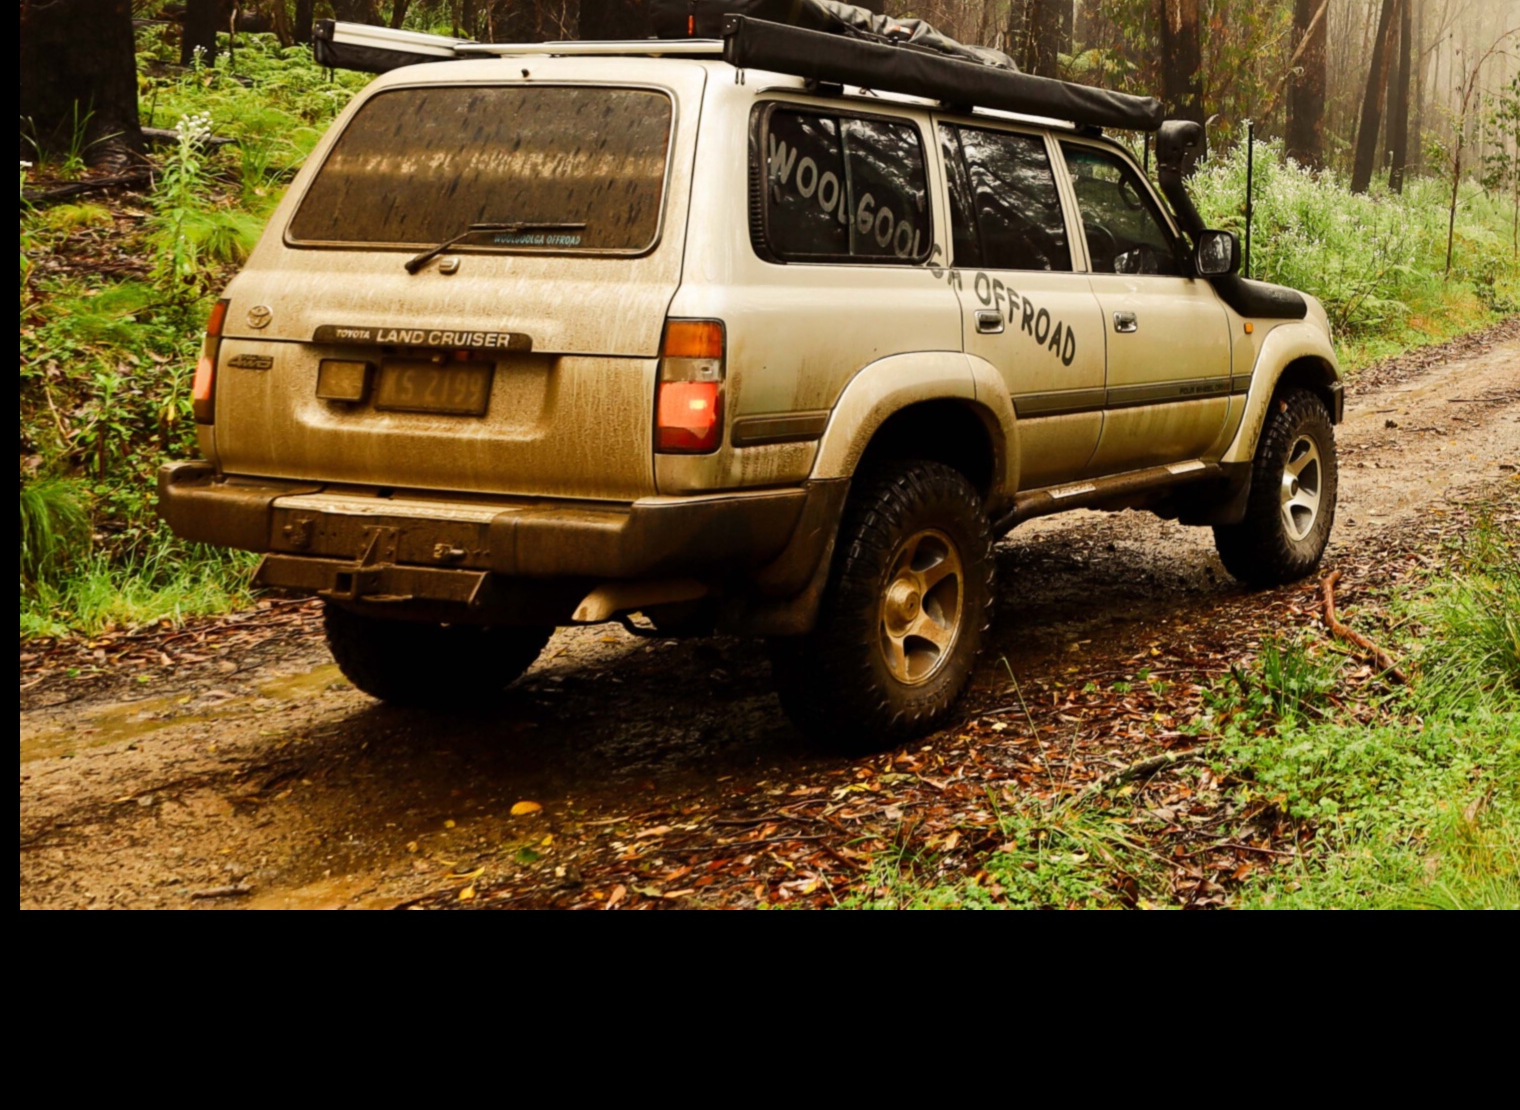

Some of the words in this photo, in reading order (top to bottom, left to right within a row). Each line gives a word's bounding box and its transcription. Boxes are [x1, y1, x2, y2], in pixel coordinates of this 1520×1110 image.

[546, 235, 581, 245] OFFROAD
[974, 272, 1076, 366] OFFROAD
[336, 329, 370, 339] TOYOTA
[377, 329, 424, 344] LAND
[429, 331, 510, 347] CRUISER
